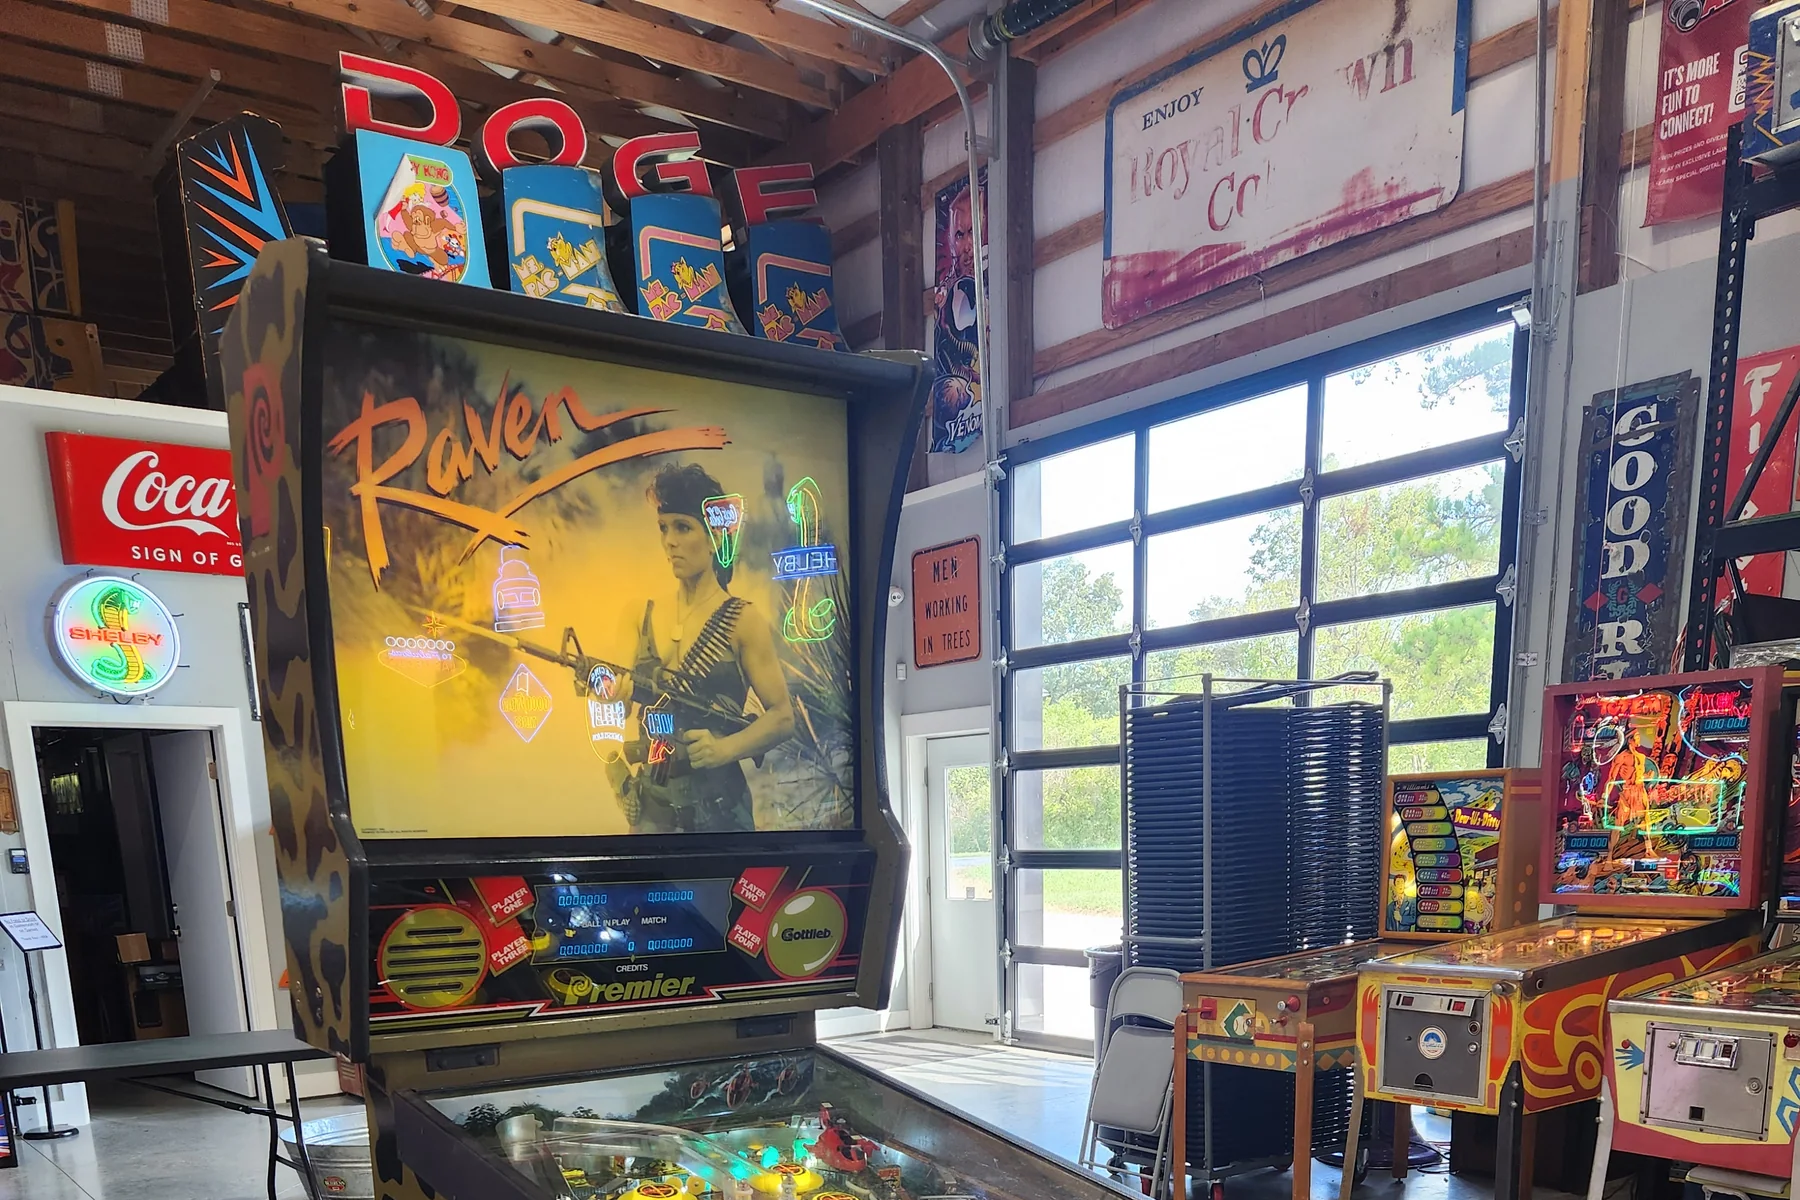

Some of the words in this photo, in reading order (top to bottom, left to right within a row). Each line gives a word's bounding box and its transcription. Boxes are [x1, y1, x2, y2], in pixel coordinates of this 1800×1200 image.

[1663, 65, 1684, 91] IT'S
[1686, 52, 1720, 83] MORE
[1252, 37, 1416, 146] Crwn
[1662, 88, 1682, 115] FUN
[1685, 84, 1700, 106] TO
[1142, 87, 1204, 130] ENJOY
[1660, 103, 1714, 140] CONNECT!
[327, 369, 732, 593] Raven
[102, 450, 236, 538] Coca
[131, 546, 182, 563] SIGN
[193, 551, 219, 566] OF
[933, 556, 958, 583] MEN
[925, 595, 968, 619] WORKING
[68, 627, 165, 647] SHELBY
[923, 636, 933, 654] IN
[942, 630, 971, 651] TREES
[491, 887, 528, 912] PLAYER
[738, 877, 766, 899] PLAYER
[740, 887, 759, 902] TWO
[503, 900, 523, 914] ONE
[582, 920, 601, 928] BALL
[611, 918, 631, 926] PLAY
[641, 916, 667, 925] MATCH
[734, 923, 761, 945] PLAYER
[734, 934, 755, 950] FOUR
[781, 928, 831, 942] Gottlieb
[491, 936, 528, 961] PLAYER
[498, 943, 529, 966] THREE
[616, 963, 648, 973] CREDITS
[563, 973, 696, 1006] Premier
